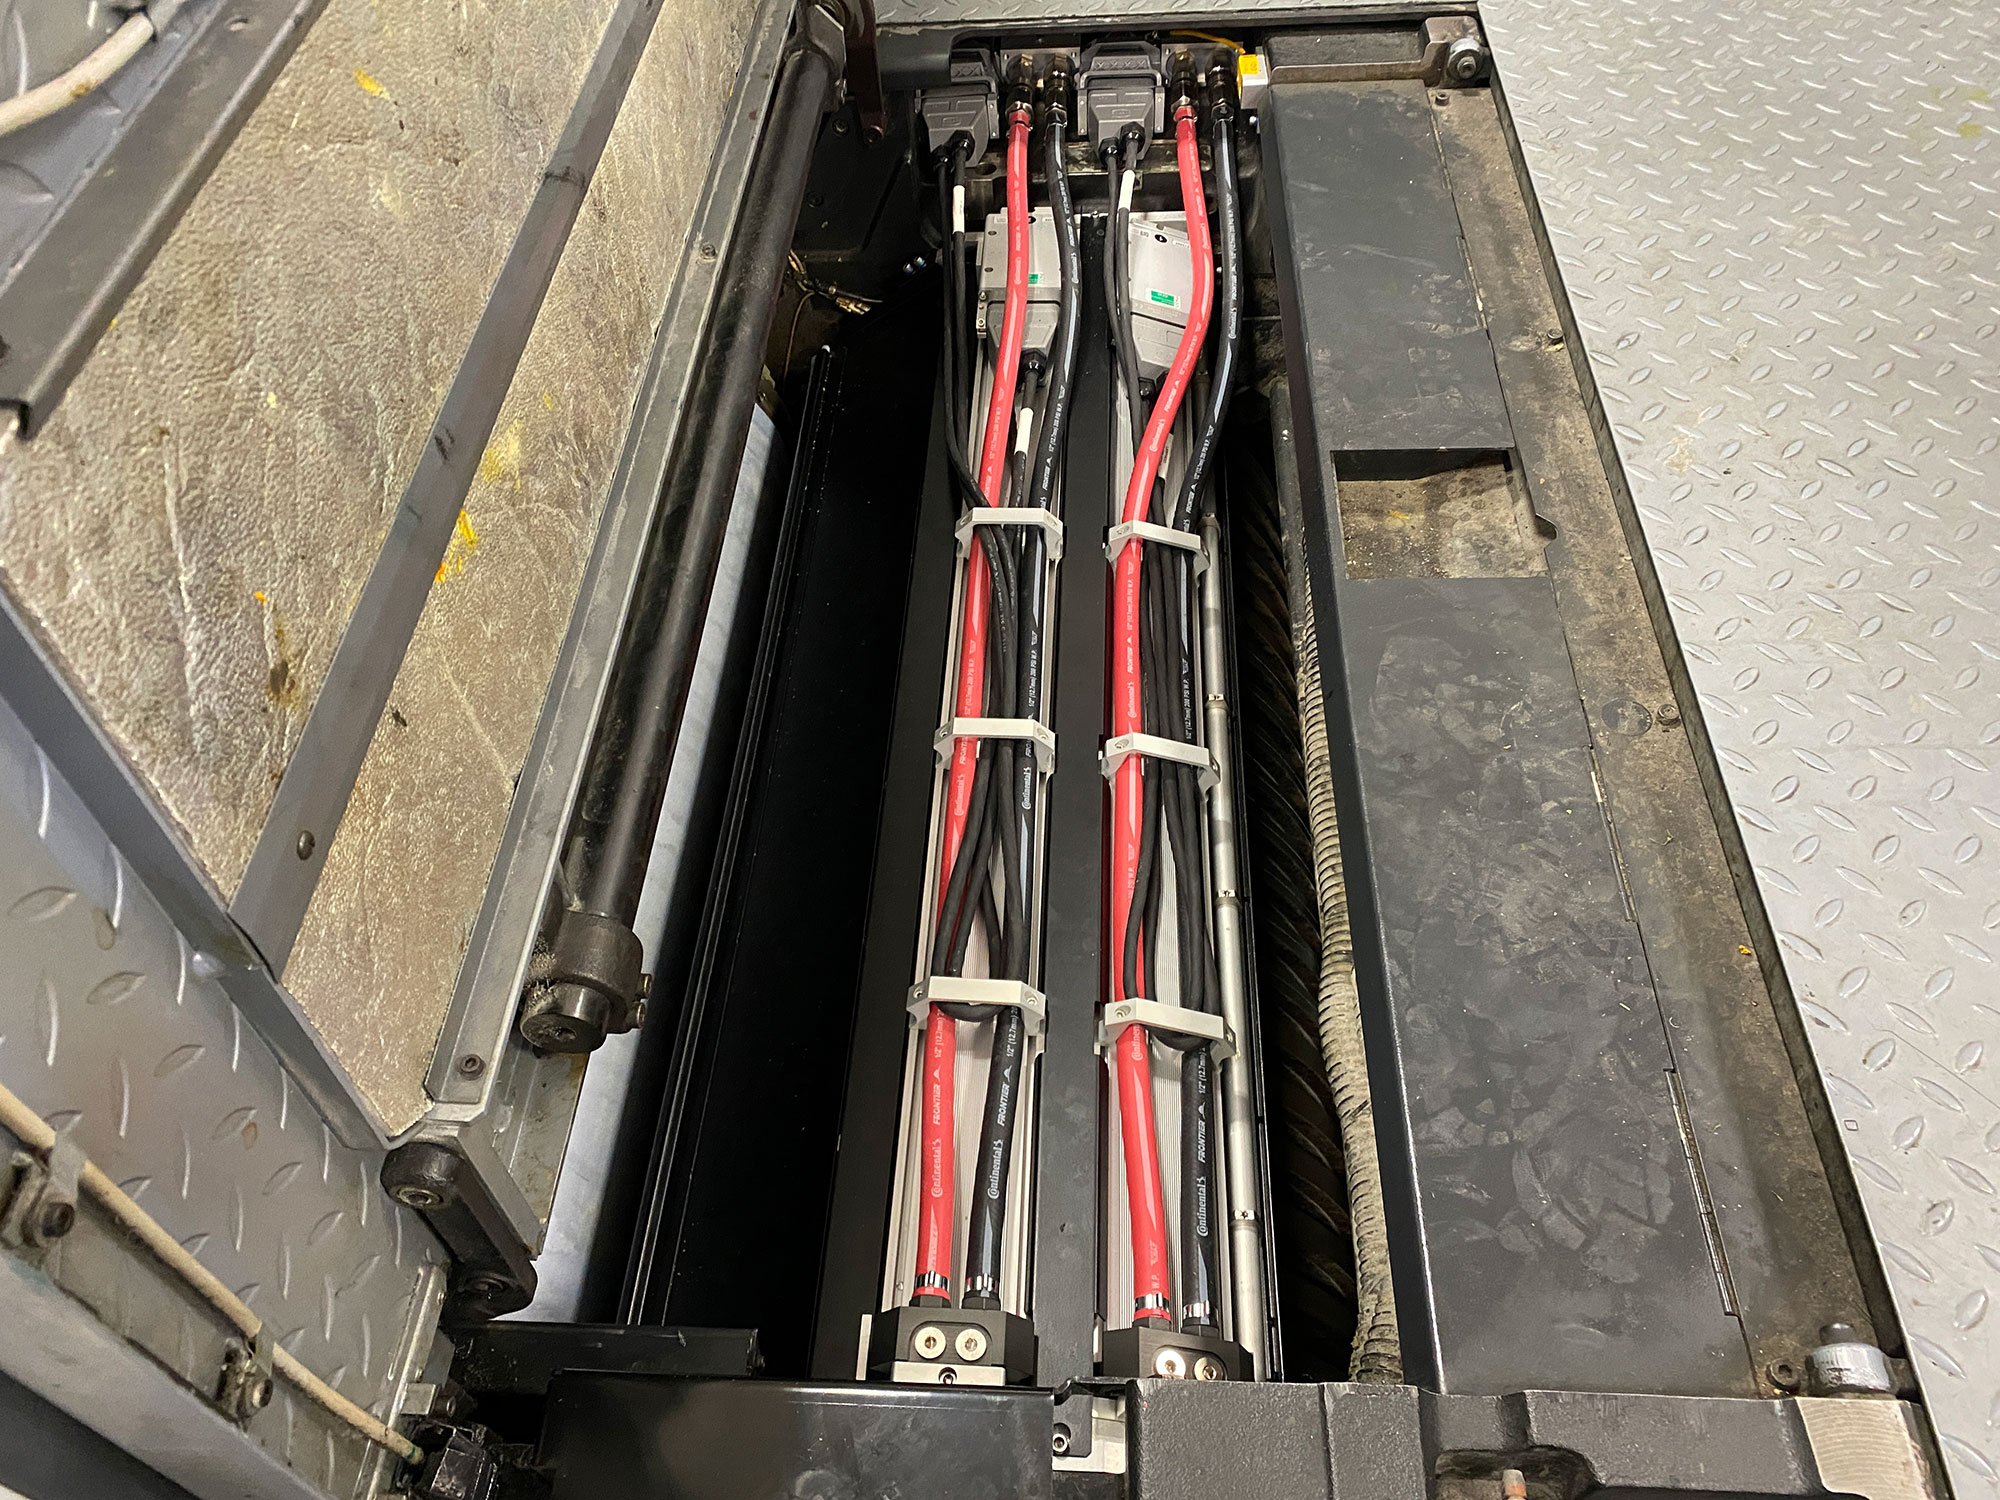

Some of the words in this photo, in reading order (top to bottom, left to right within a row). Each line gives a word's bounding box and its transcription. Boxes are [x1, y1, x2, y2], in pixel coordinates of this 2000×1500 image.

[1228, 311, 1237, 339] Continental
[1149, 421, 1165, 452] Continental
[1042, 465, 1051, 491] FRONTIER
[1127, 686, 1137, 718] Continental
[1184, 708, 1192, 729] (12.7mm)
[953, 779, 965, 816] Continental
[1021, 772, 1031, 809] Continental
[935, 1017, 945, 1045] (12.7mm)
[1007, 1015, 1018, 1044] (12.7mm)
[1131, 1024, 1143, 1061] Continen
[934, 1046, 942, 1058] 1/2"
[1006, 1045, 1014, 1057] 1/2"
[1198, 1052, 1207, 1081] (12.7mm)
[1198, 1081, 1206, 1094] 1/2"
[933, 1084, 941, 1126] FRONTIER
[997, 1085, 1010, 1126] FRONTIER
[1198, 1118, 1206, 1163] FRONTIER
[931, 1146, 943, 1198] Continental
[987, 1147, 1003, 1200] Continental
[1196, 1183, 1208, 1237] Continental
[1151, 1273, 1160, 1289] W.P.
